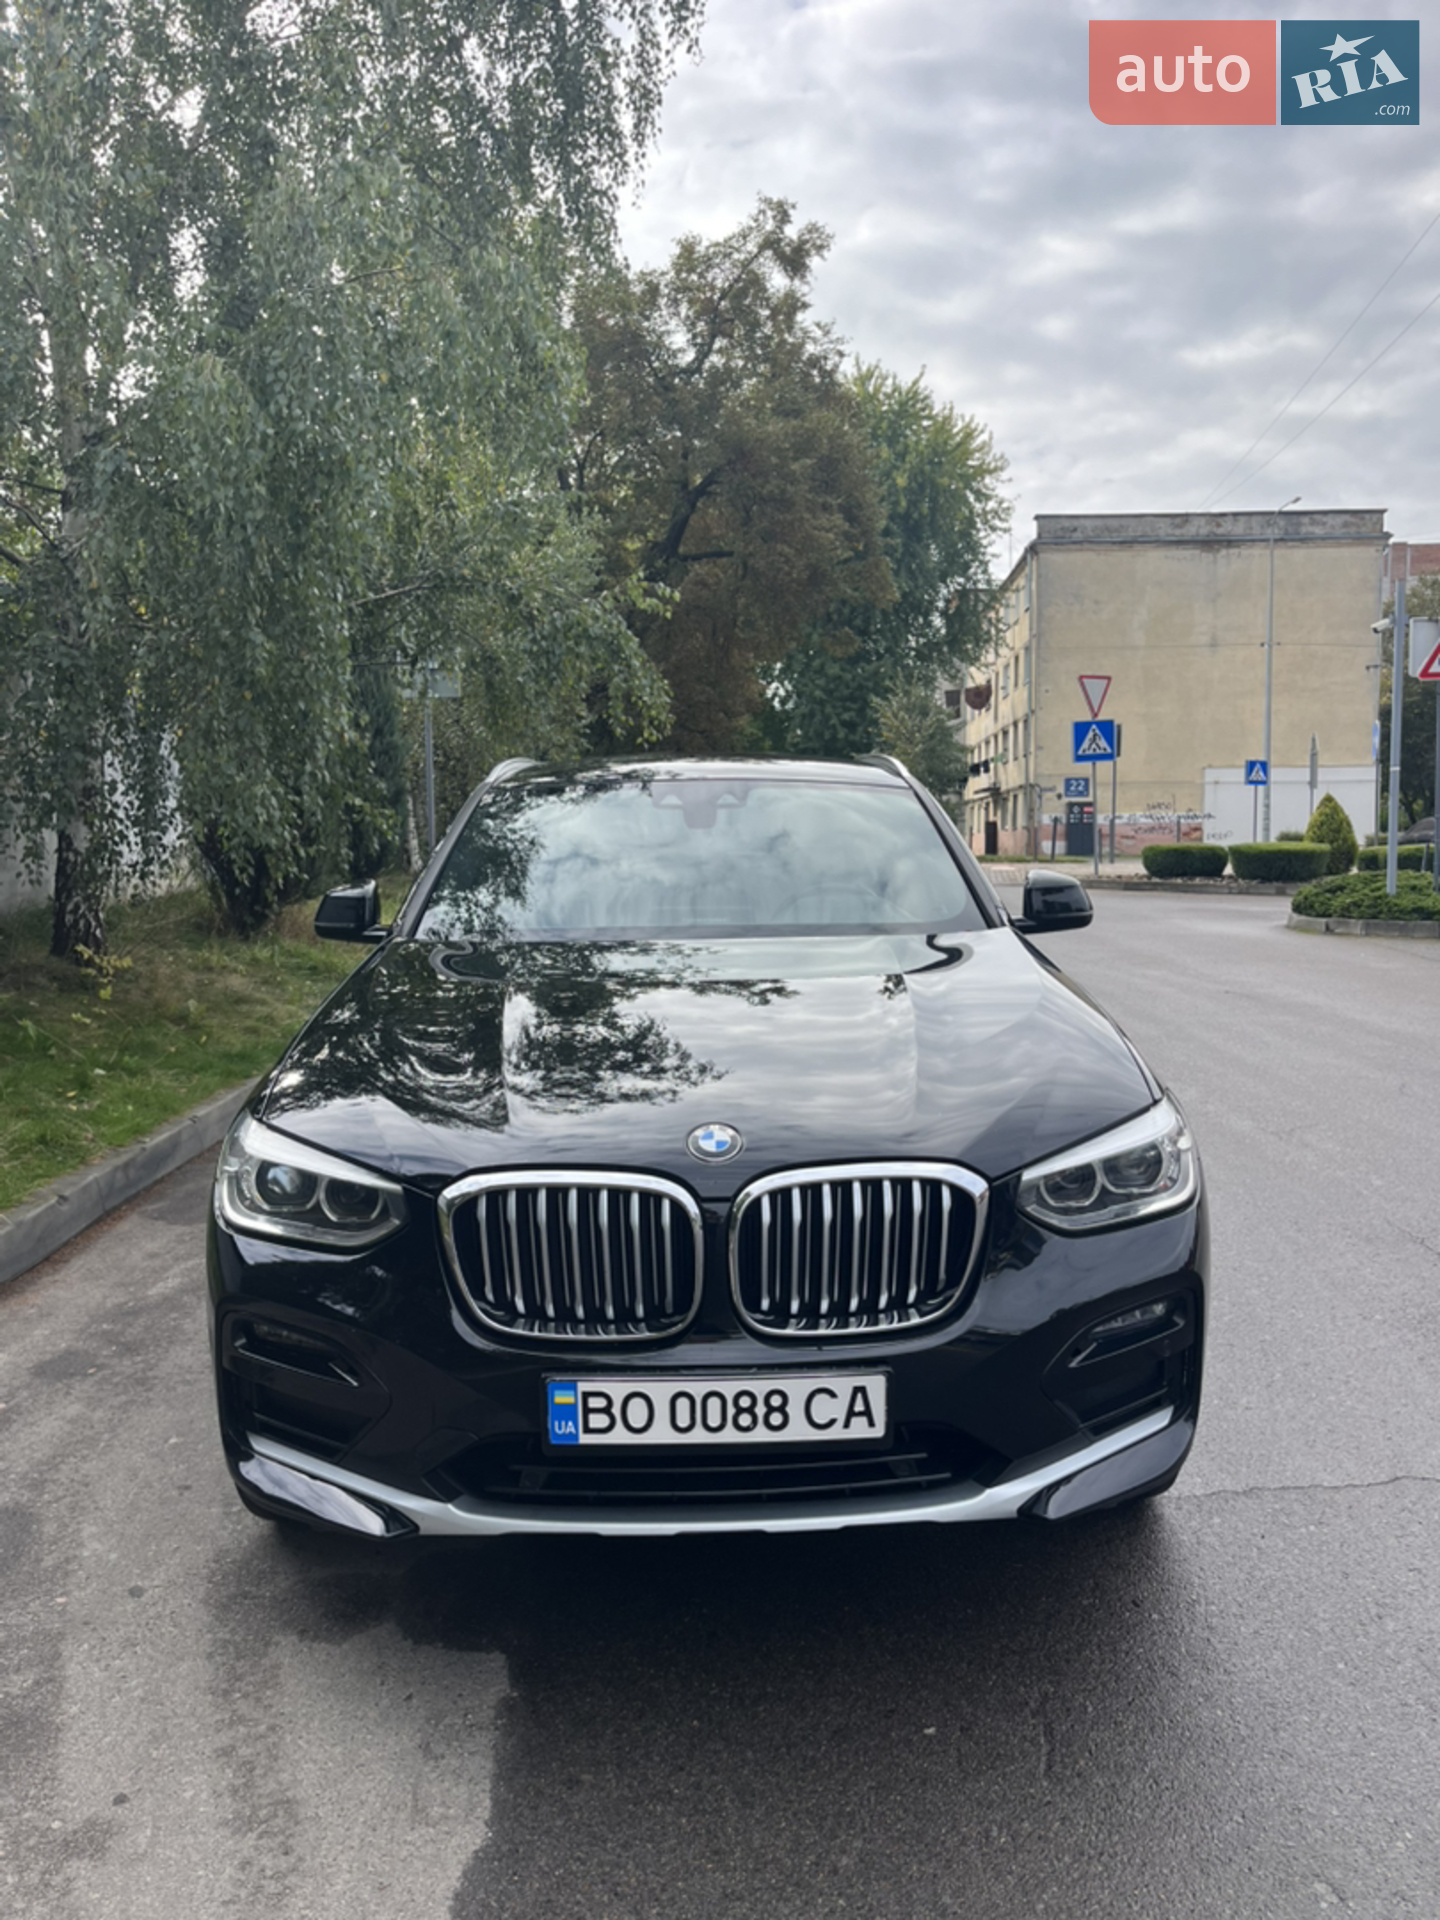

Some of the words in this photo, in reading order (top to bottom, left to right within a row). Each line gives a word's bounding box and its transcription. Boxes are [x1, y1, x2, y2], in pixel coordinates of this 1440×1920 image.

[1069, 779, 1085, 791] 22
[581, 1390, 655, 1434] BO
[670, 1388, 789, 1433] 0088
[804, 1386, 876, 1430] CA
[554, 1421, 576, 1435] UA
